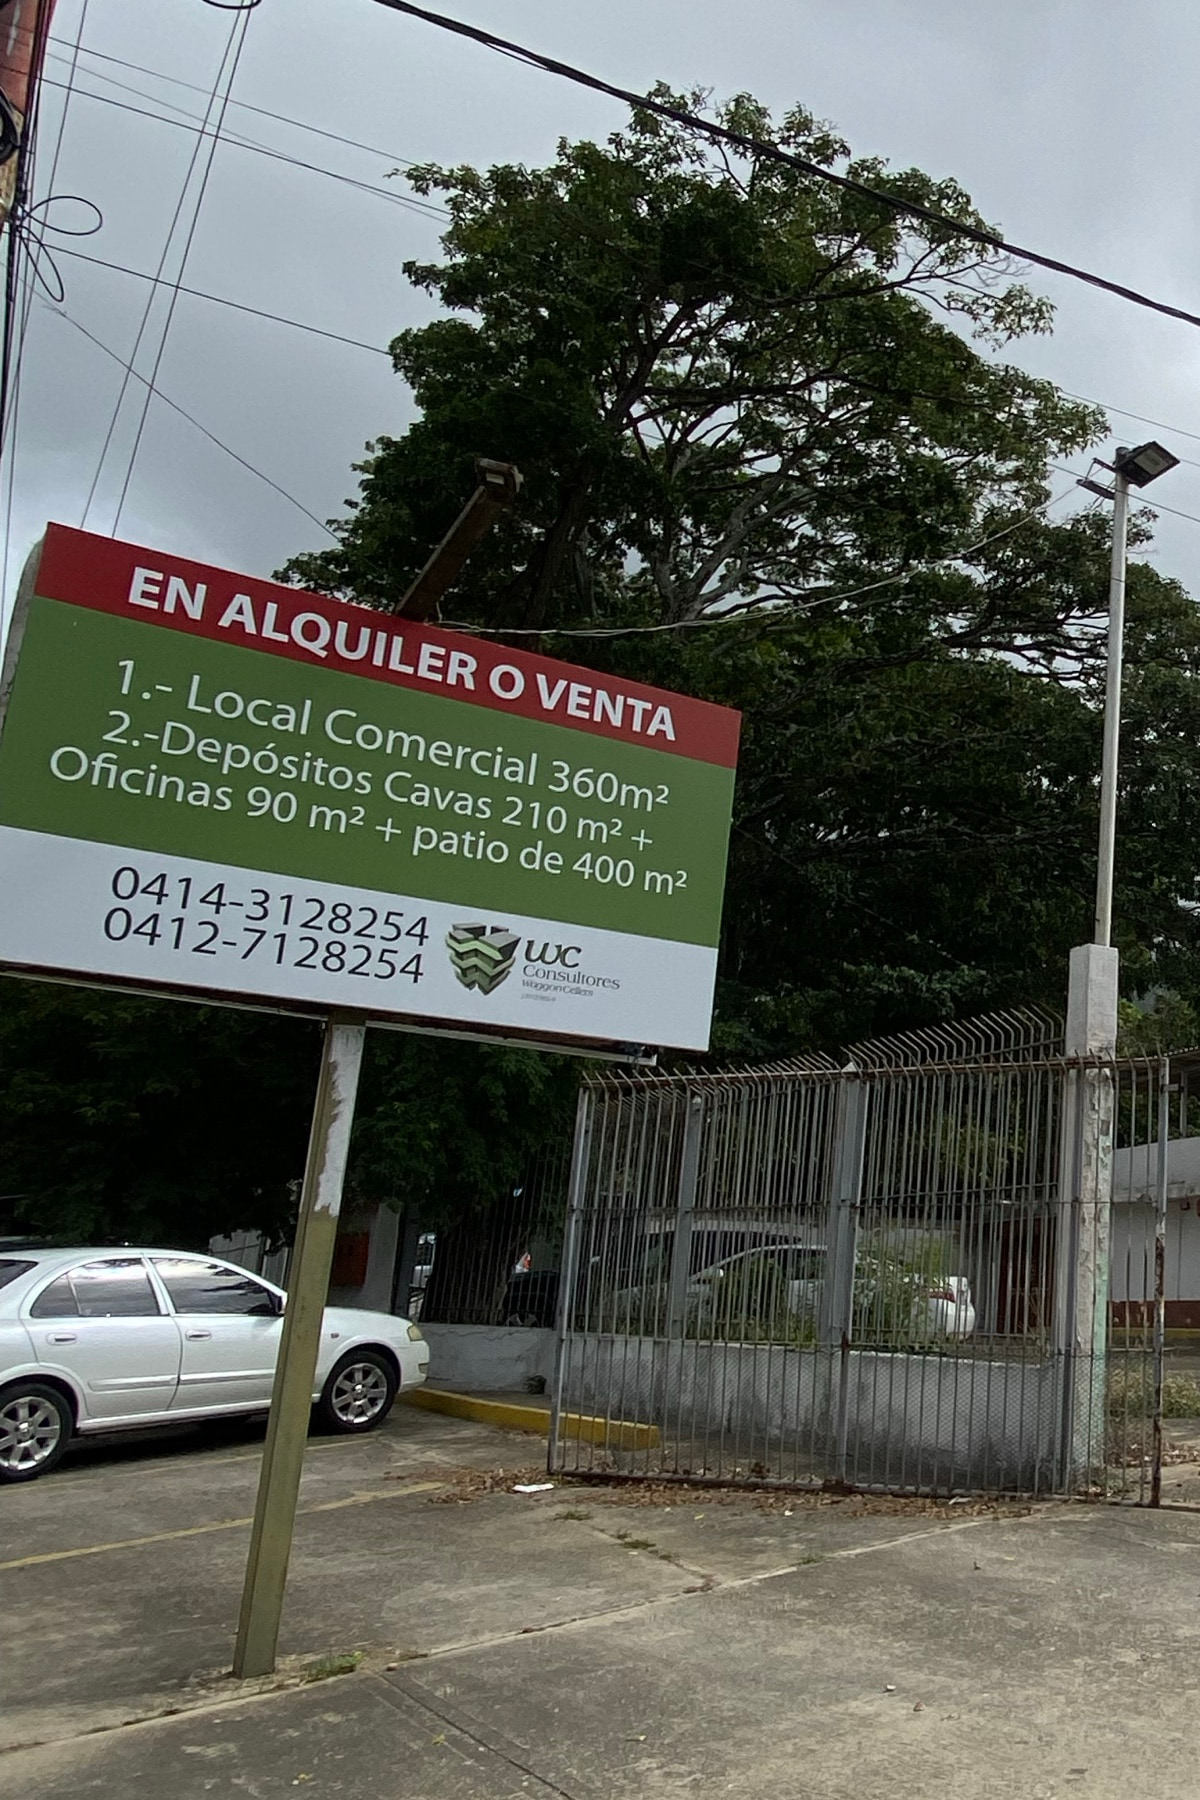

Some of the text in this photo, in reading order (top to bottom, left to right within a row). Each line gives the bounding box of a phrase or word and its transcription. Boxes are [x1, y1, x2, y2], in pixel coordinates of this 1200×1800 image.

[128, 566, 676, 742] EN ALQUILER O VENTA
[102, 710, 653, 852] 2.-Depósitos Cavas 210 m² +
[118, 659, 173, 700] 1.-
[187, 674, 312, 735] Local
[325, 709, 538, 786] Comercial
[50, 746, 688, 897] Oficinas 90 m² + patio de 400 m²
[104, 907, 424, 984] 0412-7128254
[111, 866, 429, 947] 0414-3128254
[522, 964, 621, 990] Consultores
